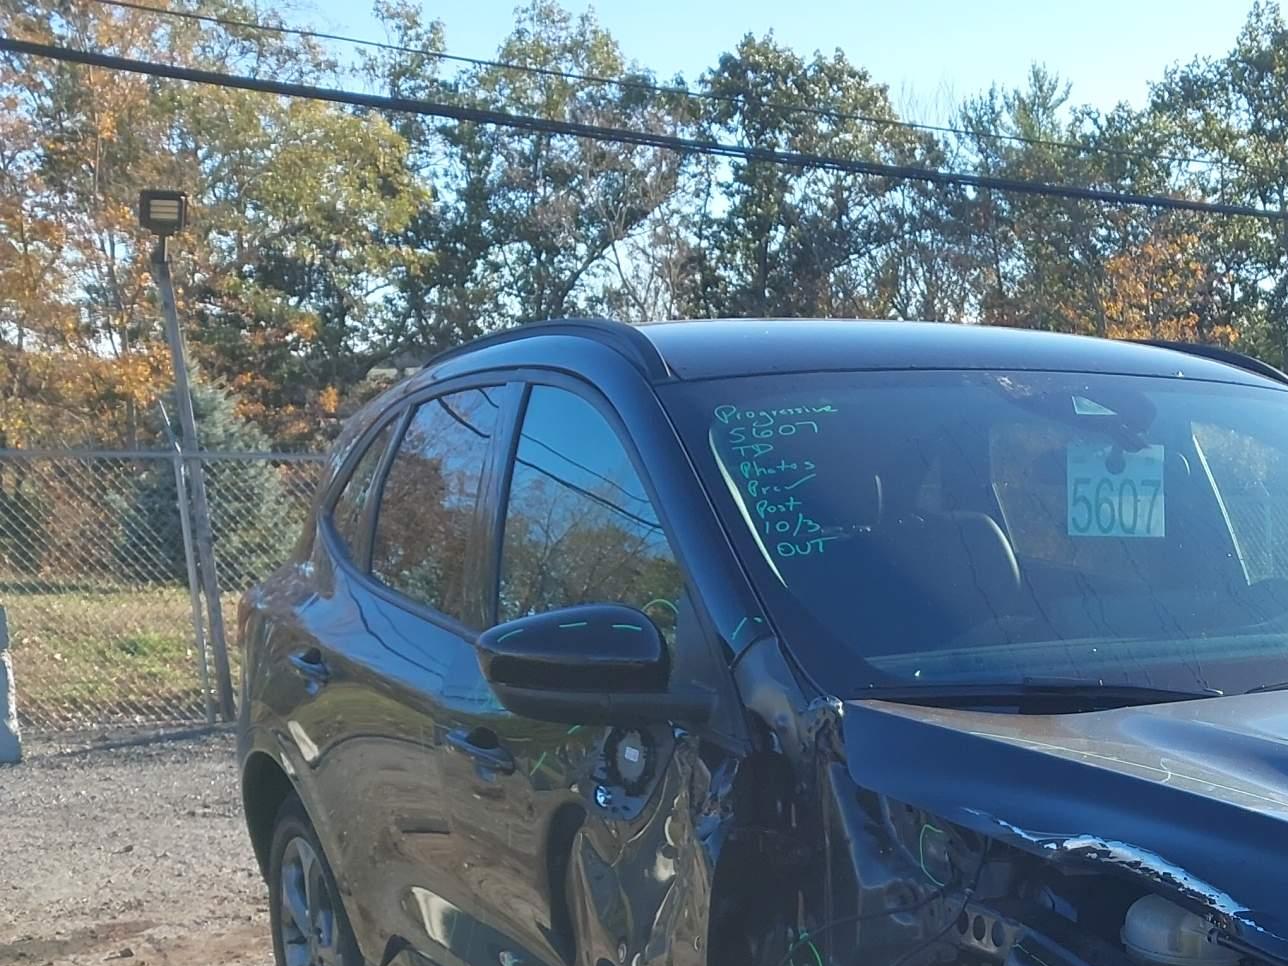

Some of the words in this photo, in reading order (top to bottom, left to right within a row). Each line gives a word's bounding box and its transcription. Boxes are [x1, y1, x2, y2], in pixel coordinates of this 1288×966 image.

[714, 404, 838, 427] Progressive
[729, 421, 818, 443] 5607
[756, 497, 802, 519] Post
[1071, 477, 1161, 535] 5607
[766, 513, 820, 537] 10/3
[777, 536, 838, 556] OUT
